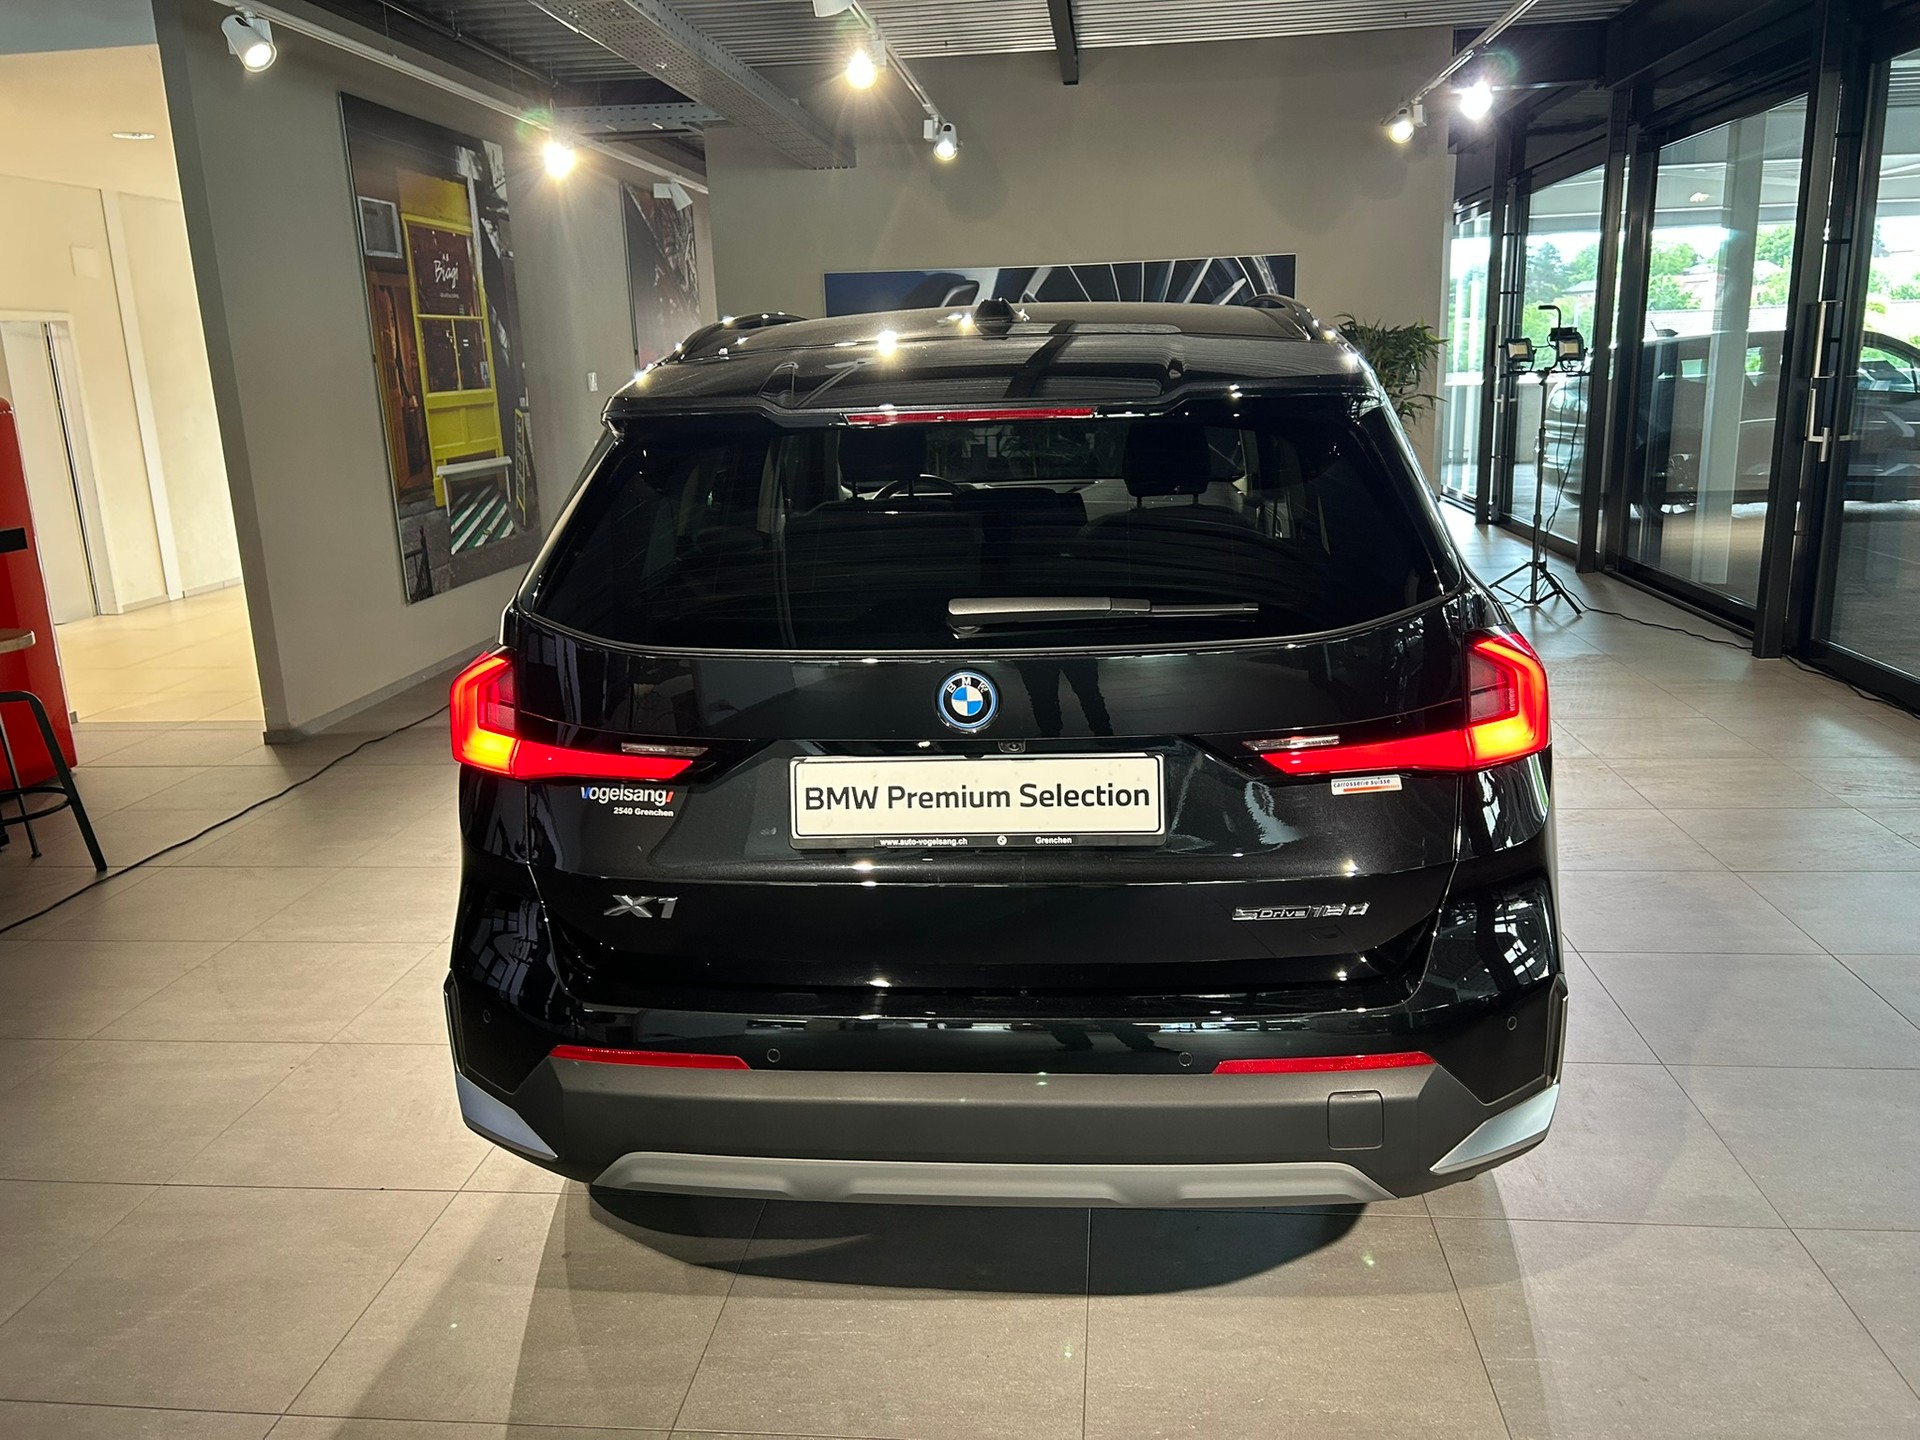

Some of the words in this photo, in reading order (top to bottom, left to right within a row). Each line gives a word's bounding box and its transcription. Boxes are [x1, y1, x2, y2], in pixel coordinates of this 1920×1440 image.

[946, 677, 989, 693] BMW
[1333, 780, 1369, 789] carrosserie
[1370, 778, 1391, 786] suisse
[805, 786, 879, 810] BMW
[888, 784, 1011, 808] Premium
[1020, 783, 1150, 807] Selection
[613, 807, 633, 815] 2540
[634, 808, 674, 817] Grenchen
[880, 838, 968, 847] www.auto-vogelsang.ch
[1035, 836, 1072, 844] Grenchen
[603, 894, 678, 919] X1
